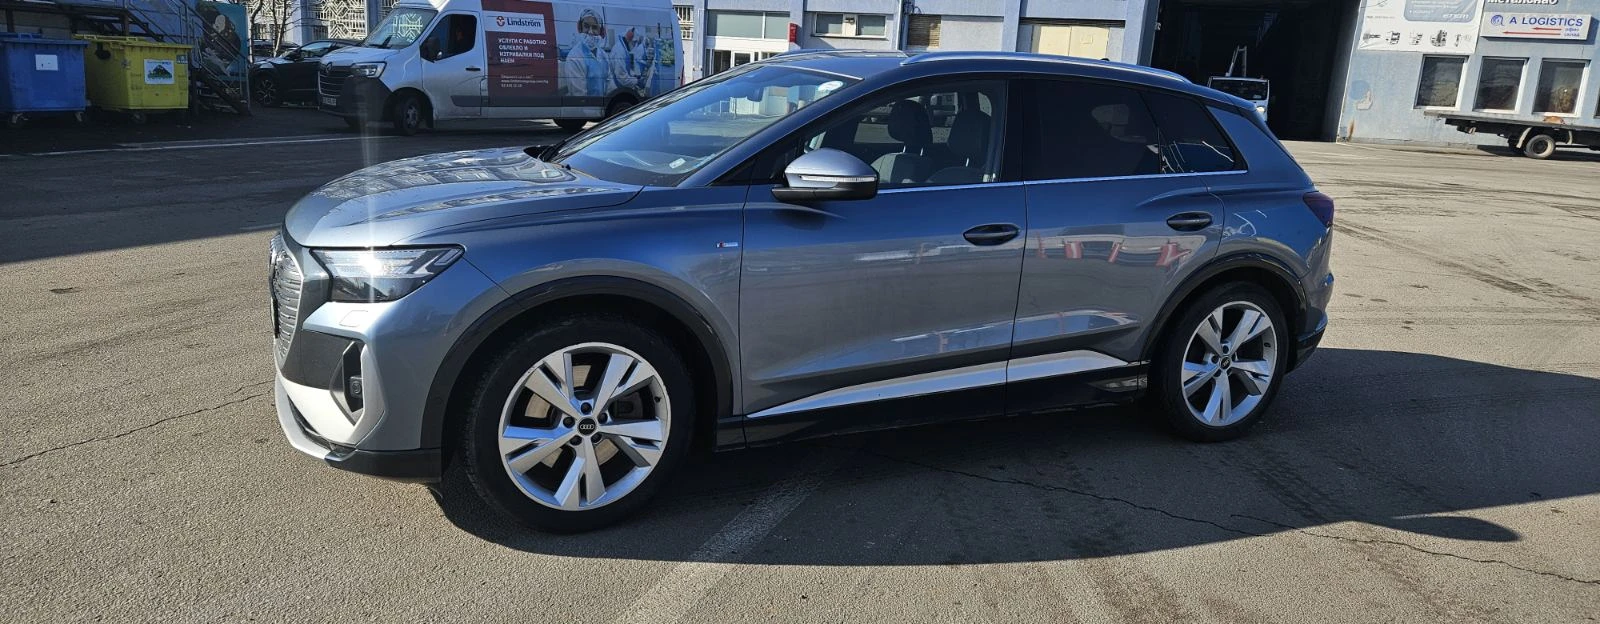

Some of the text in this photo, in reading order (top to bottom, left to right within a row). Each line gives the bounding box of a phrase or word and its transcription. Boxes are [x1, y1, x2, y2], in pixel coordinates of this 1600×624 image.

[507, 17, 542, 27] Lindström
[1509, 16, 1583, 27] A LOGISTICS
